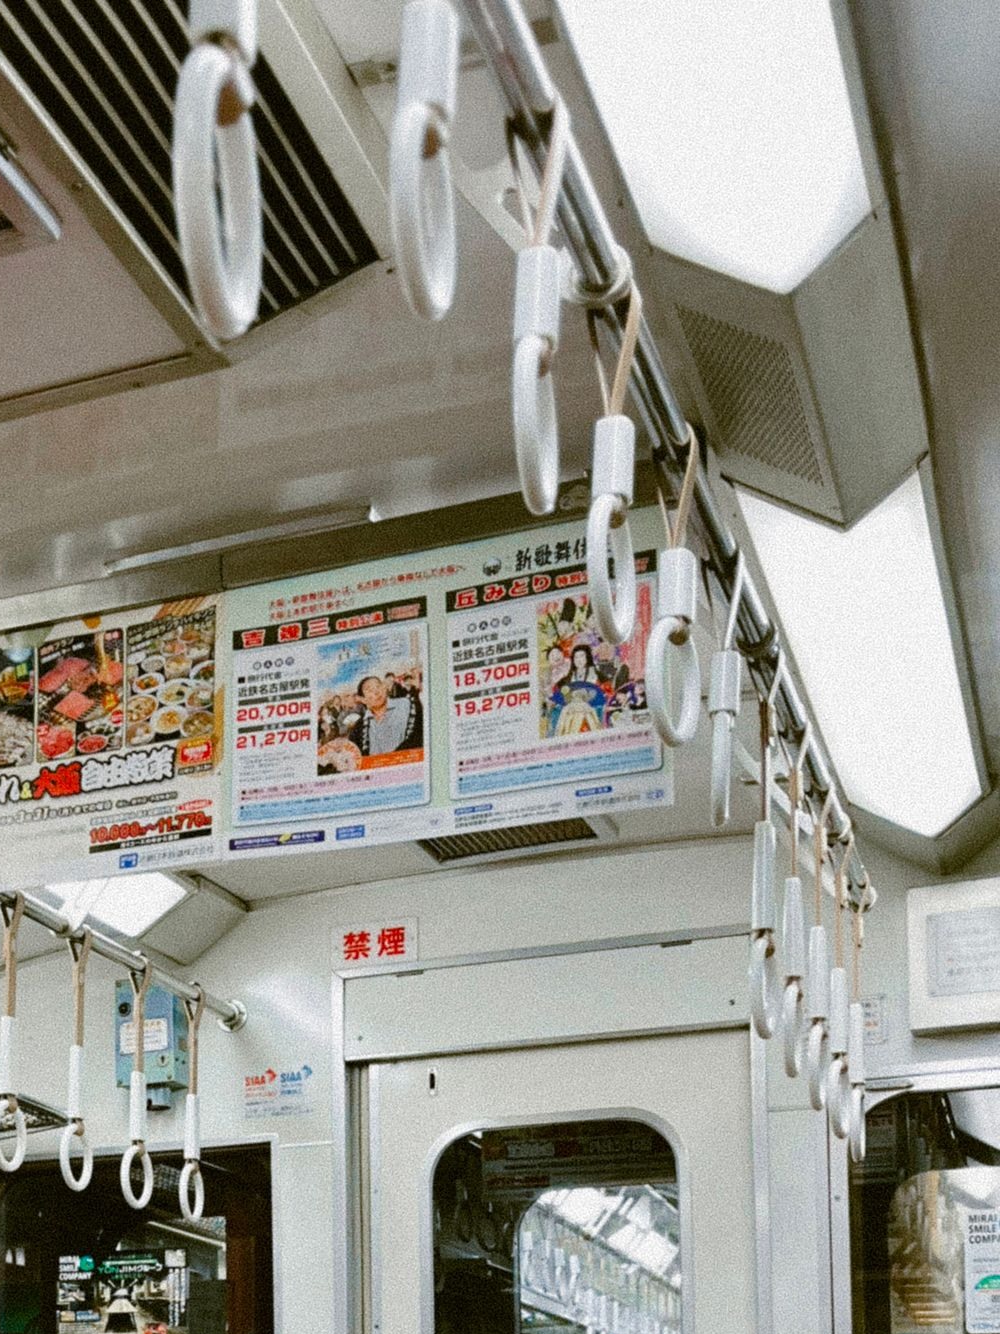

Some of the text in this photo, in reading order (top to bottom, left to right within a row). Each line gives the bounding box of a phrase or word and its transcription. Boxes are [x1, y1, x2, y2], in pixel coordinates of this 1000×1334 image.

[452, 638, 529, 663] 近鉄名古屋駅発
[454, 663, 530, 687] 18,700円
[238, 678, 310, 698] 近鉄名古屋駅発
[237, 701, 311, 722] 20,700円
[455, 692, 531, 716] 19,270円
[236, 729, 311, 749] 21,270円
[343, 927, 406, 960] 禁煙
[968, 1225, 997, 1234] SMILE
